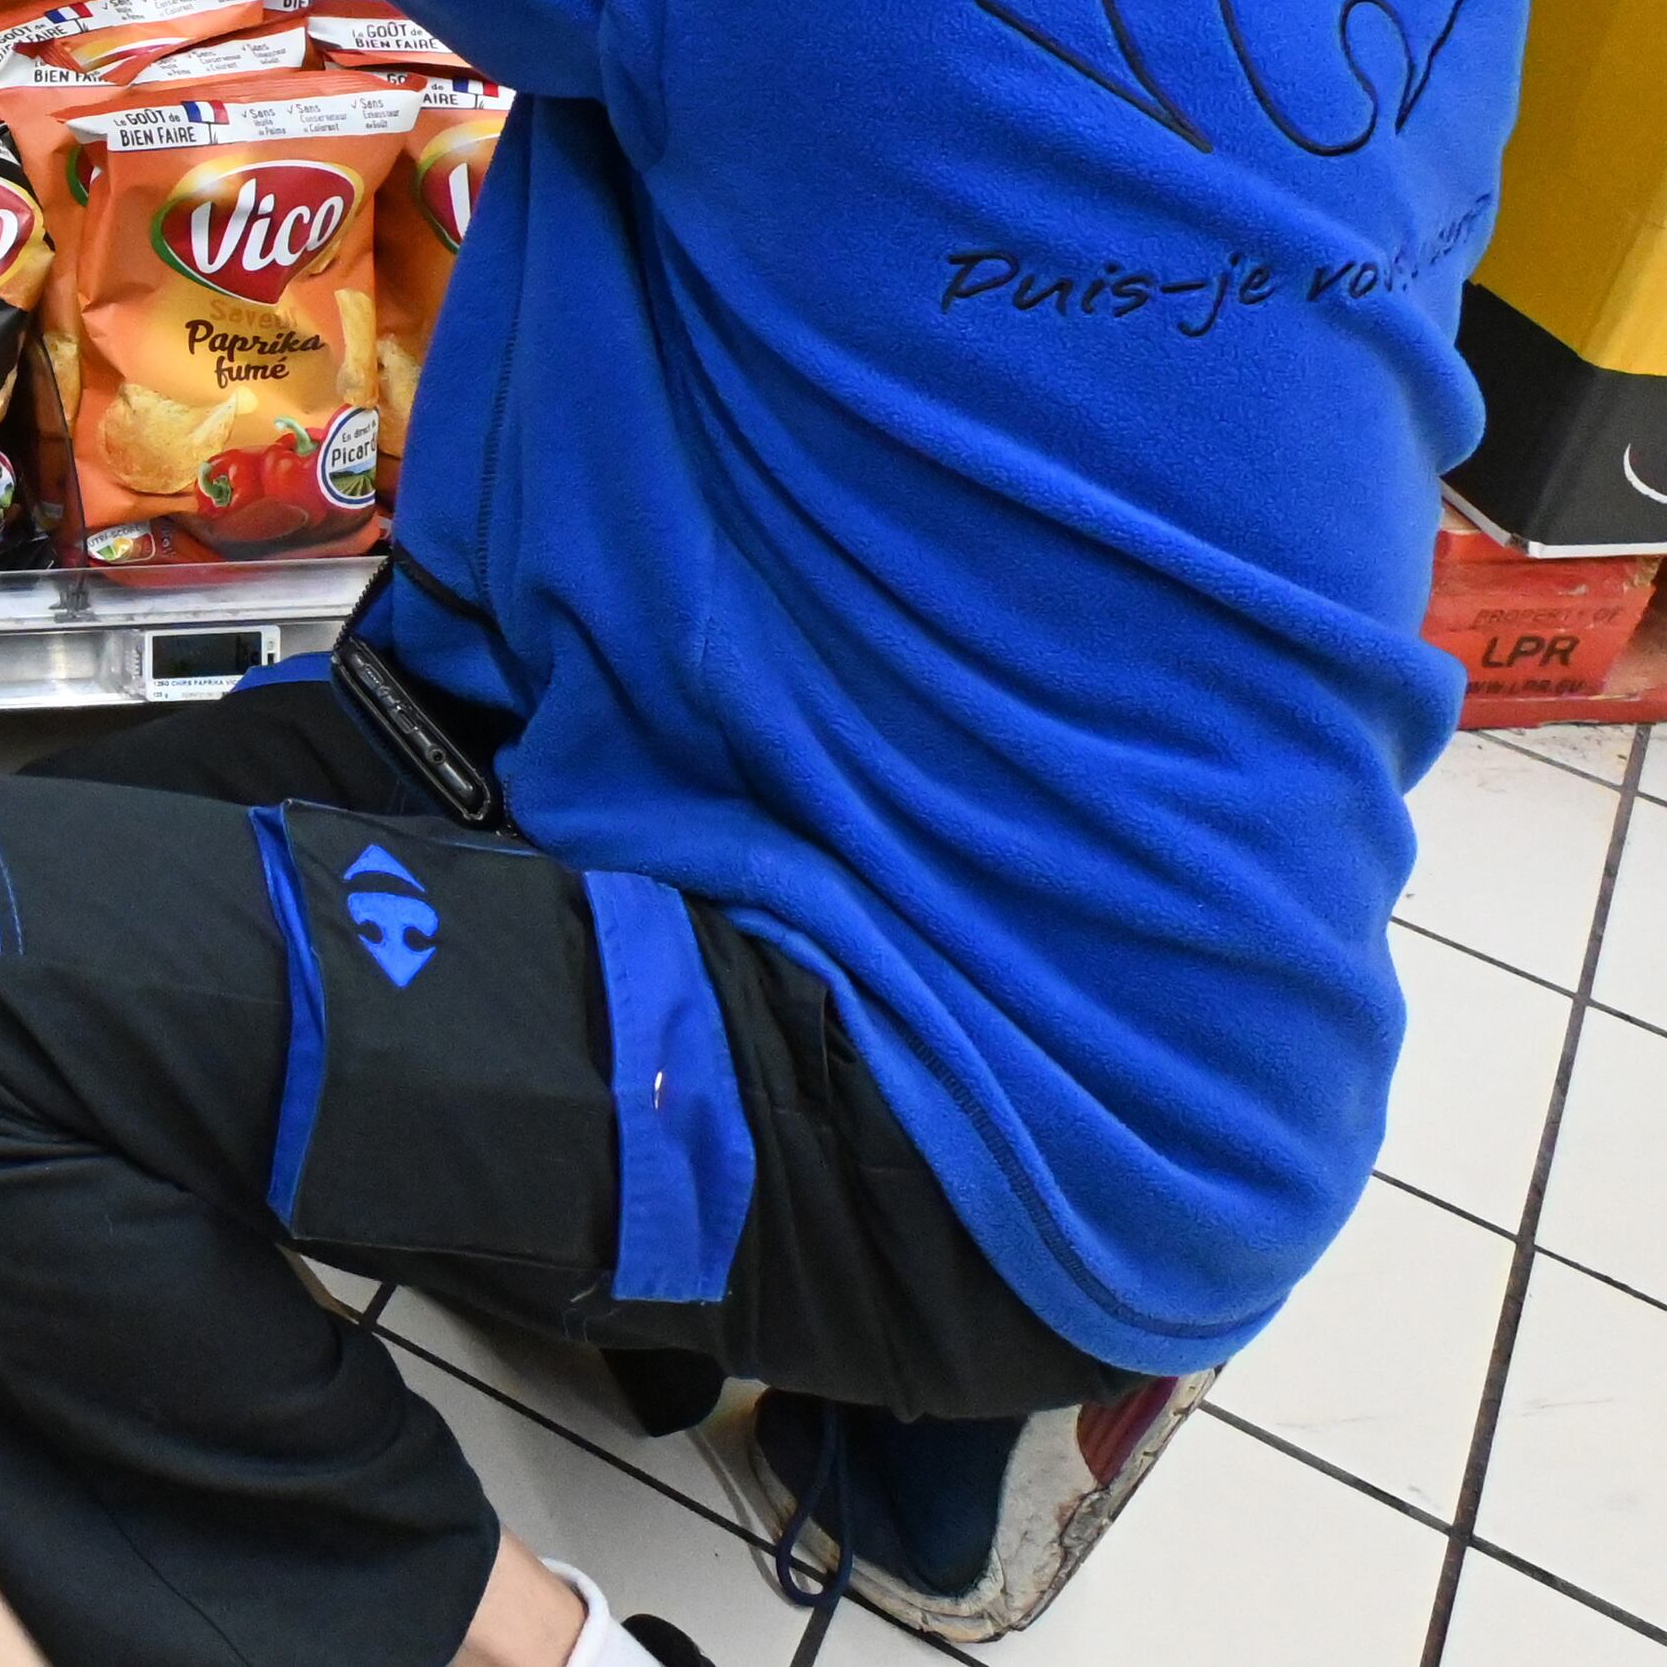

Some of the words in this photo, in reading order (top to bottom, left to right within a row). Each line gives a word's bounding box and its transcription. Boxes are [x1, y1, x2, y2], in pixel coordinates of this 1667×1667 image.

[191, 180, 343, 274] Vico
[941, 251, 1275, 337] Puis-je
[185, 320, 324, 361] Paprika
[215, 356, 289, 389] fumé
[1482, 636, 1581, 669] LPR
